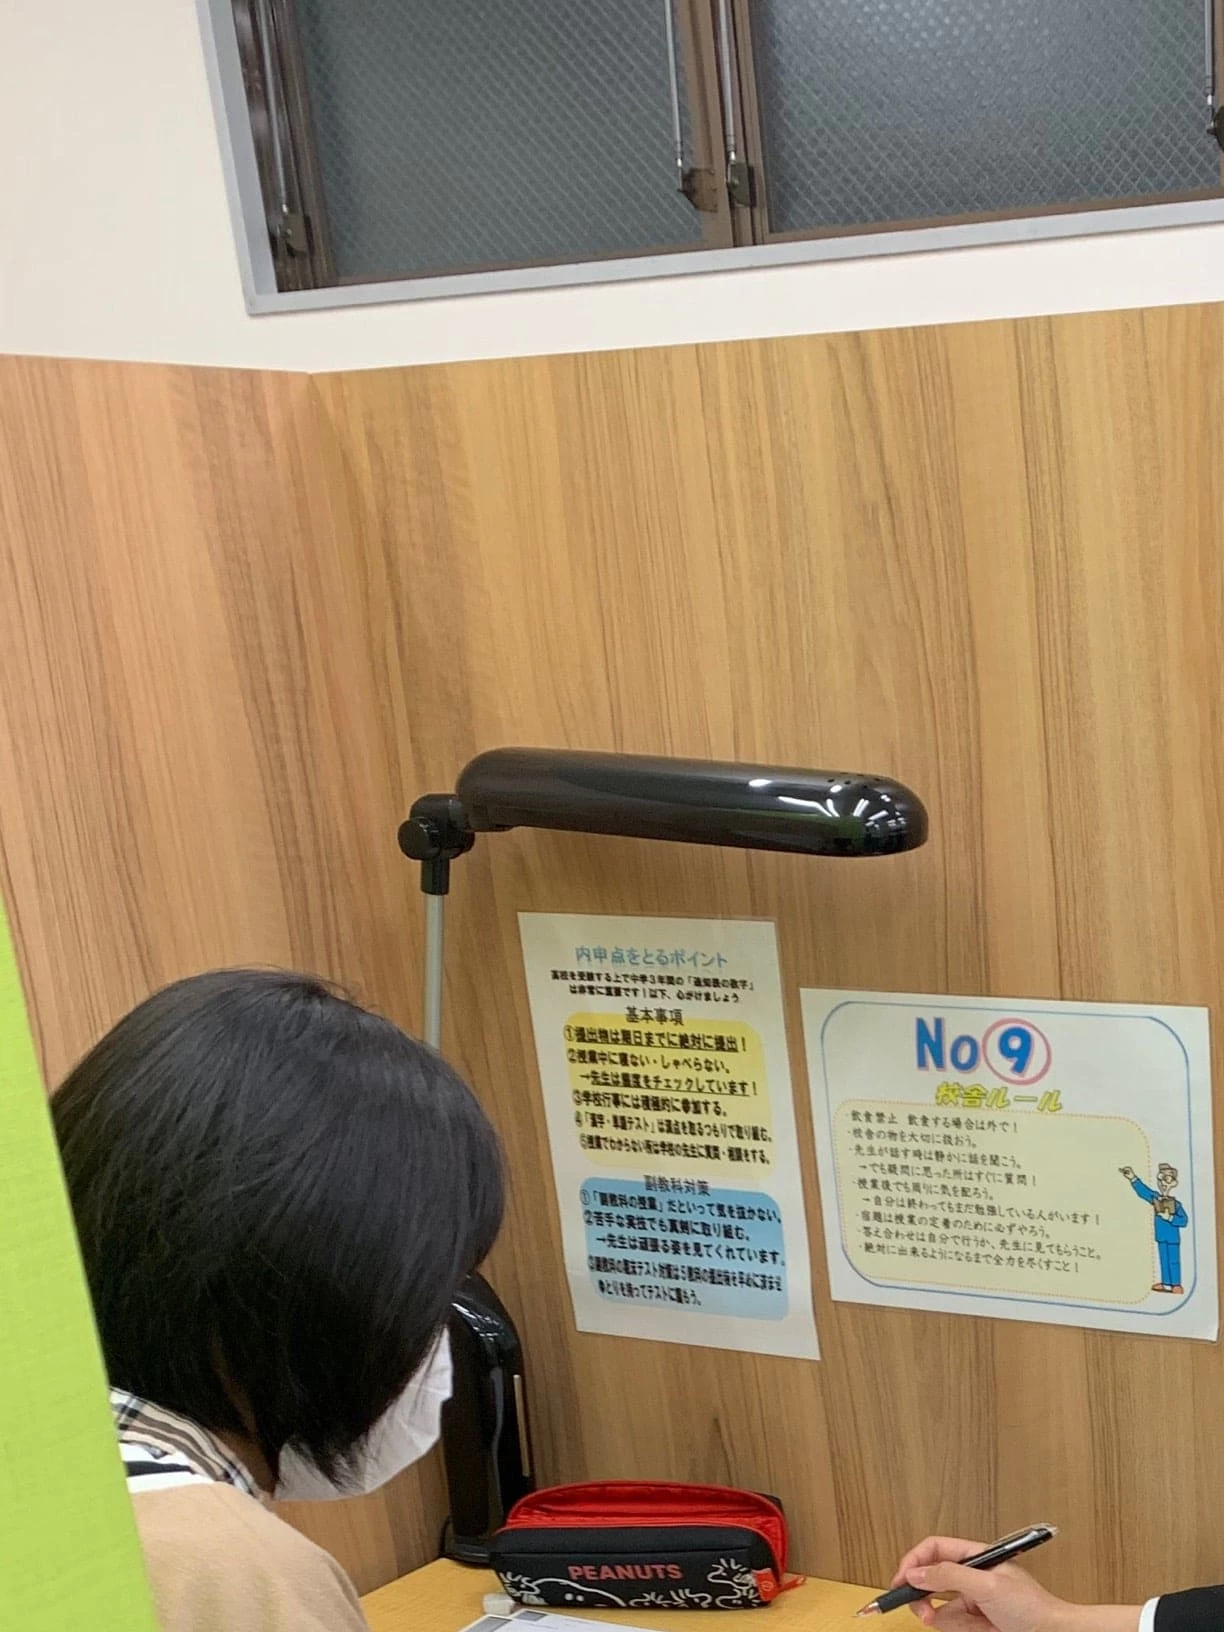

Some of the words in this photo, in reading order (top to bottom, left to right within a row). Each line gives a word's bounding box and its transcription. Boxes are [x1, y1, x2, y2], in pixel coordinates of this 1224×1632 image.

[575, 945, 728, 968] 内申点をとるポイント
[625, 1005, 684, 1026] 基本事項
[934, 1081, 1063, 1112] 校舎ルール
[643, 1174, 711, 1196] 副教科対策
[568, 1563, 683, 1581] PEANUTS
